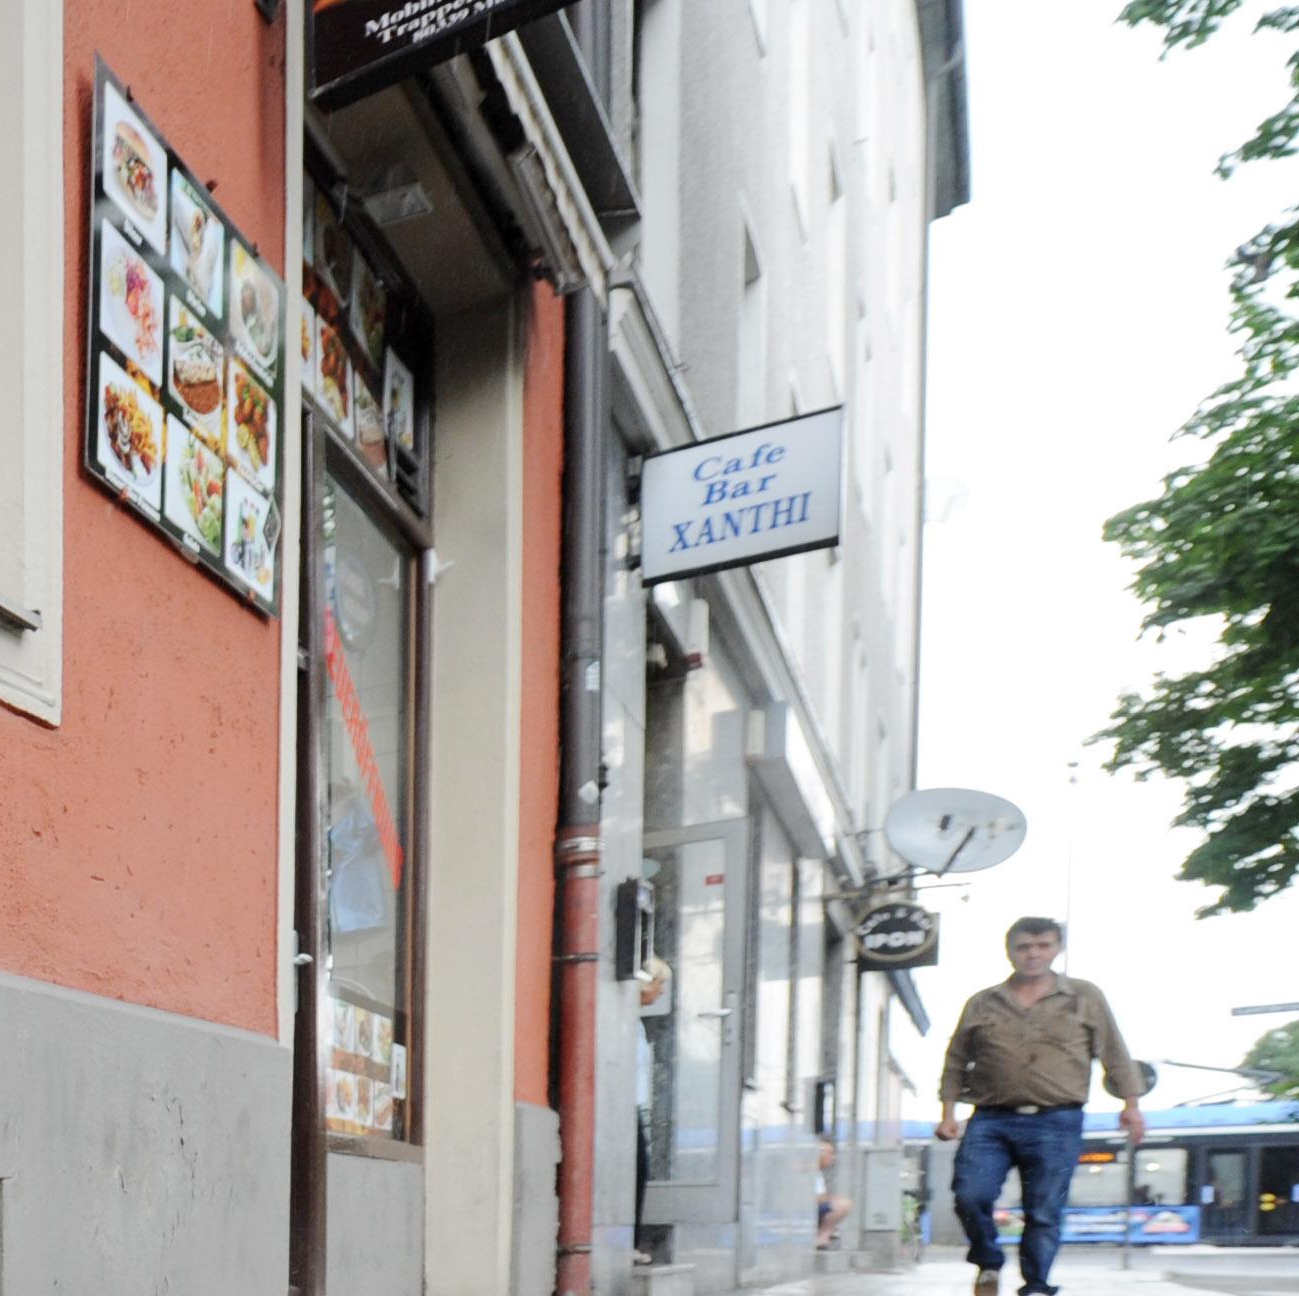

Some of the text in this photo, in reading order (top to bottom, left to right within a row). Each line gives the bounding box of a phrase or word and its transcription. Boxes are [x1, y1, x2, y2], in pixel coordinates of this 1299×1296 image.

[693, 442, 787, 482] Cafe
[701, 474, 777, 506] Bar
[667, 491, 813, 554] XANTHI
